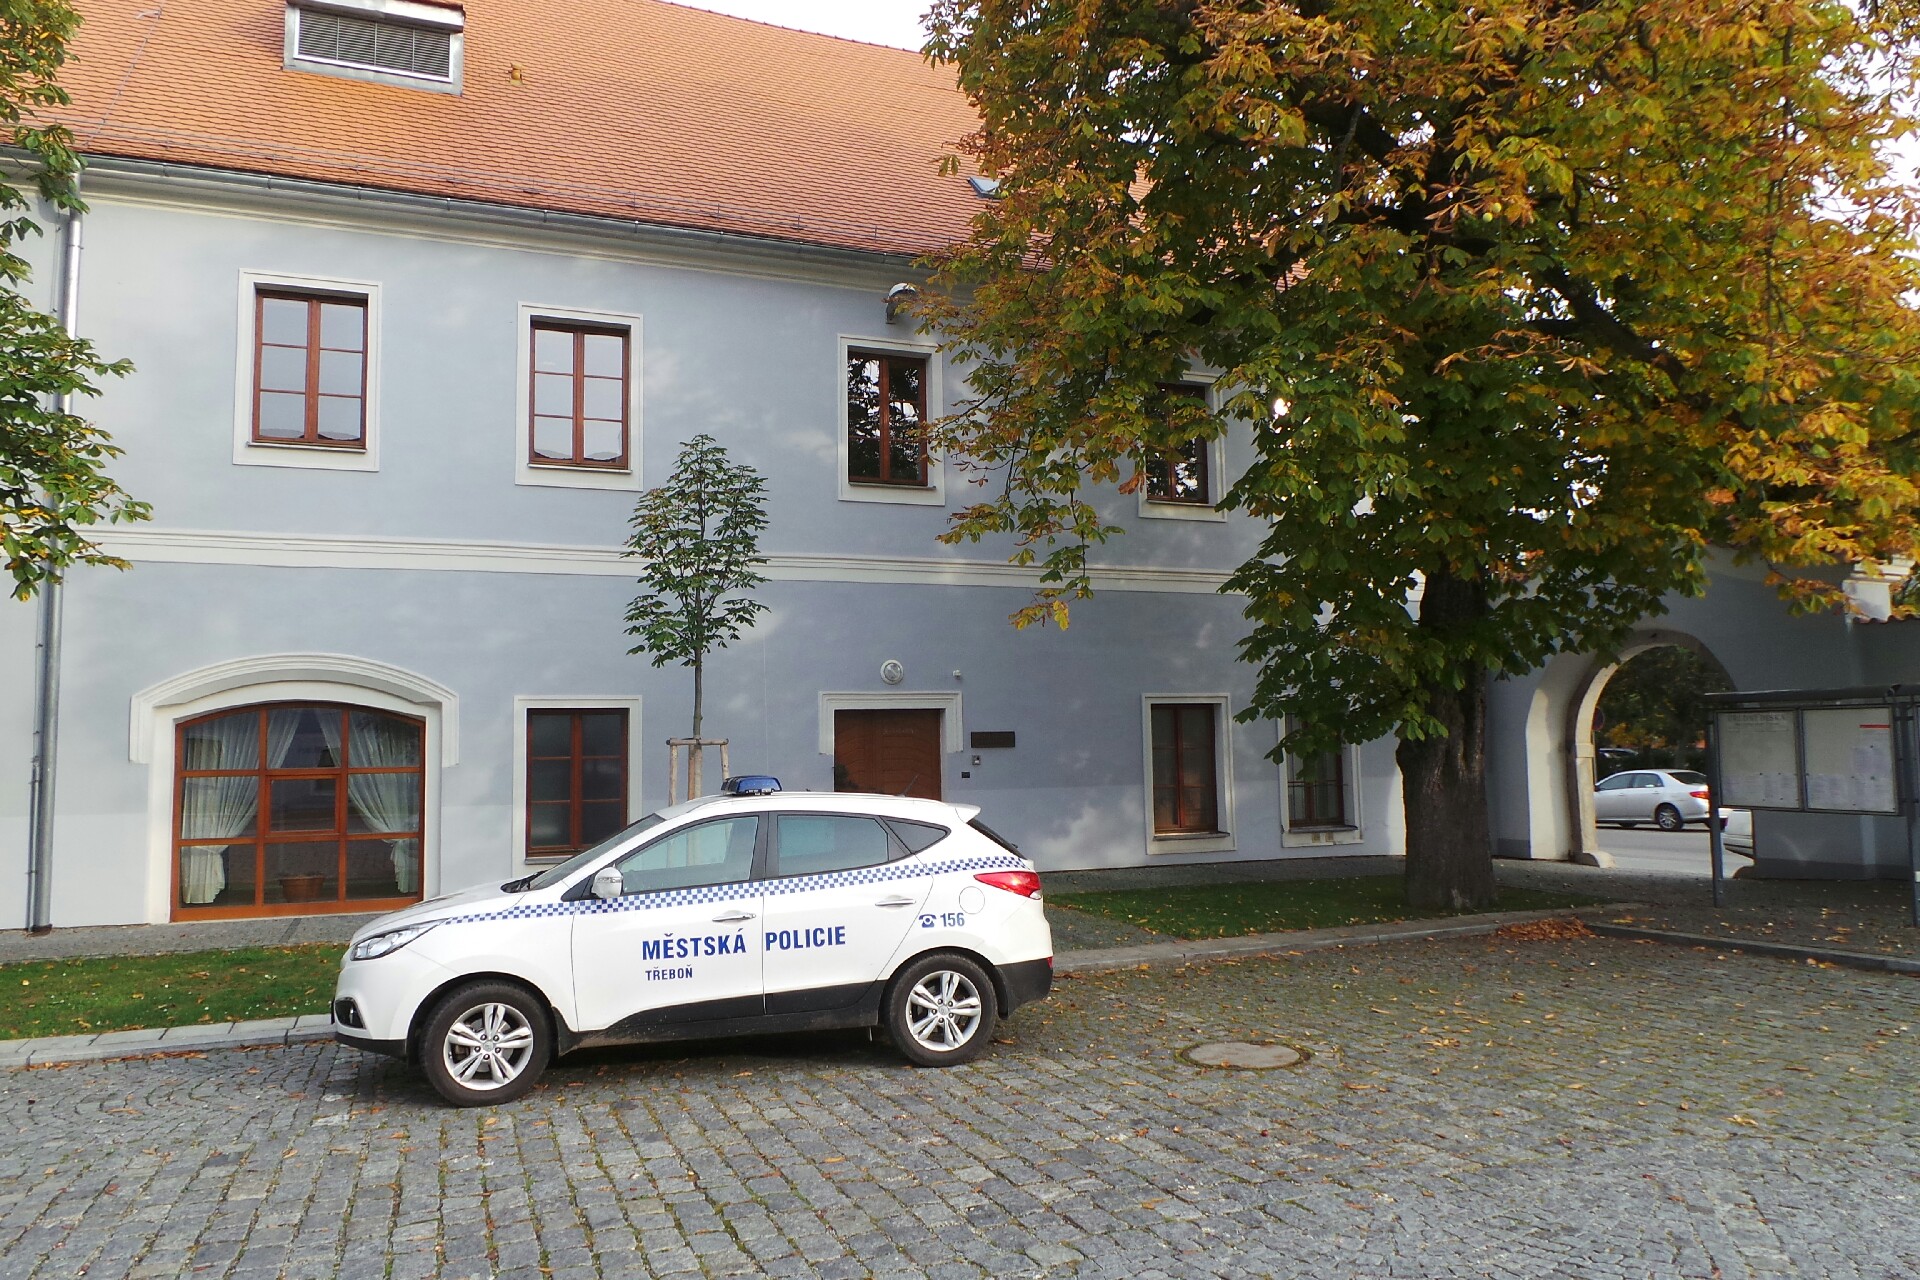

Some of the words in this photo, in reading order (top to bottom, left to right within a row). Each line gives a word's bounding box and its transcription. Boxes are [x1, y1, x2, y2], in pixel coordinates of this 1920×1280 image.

[940, 913, 966, 927] 156
[642, 927, 747, 961] MĚSTSKÁ
[765, 926, 846, 952] POLICIE
[645, 964, 693, 981] TŘEBOŇ
